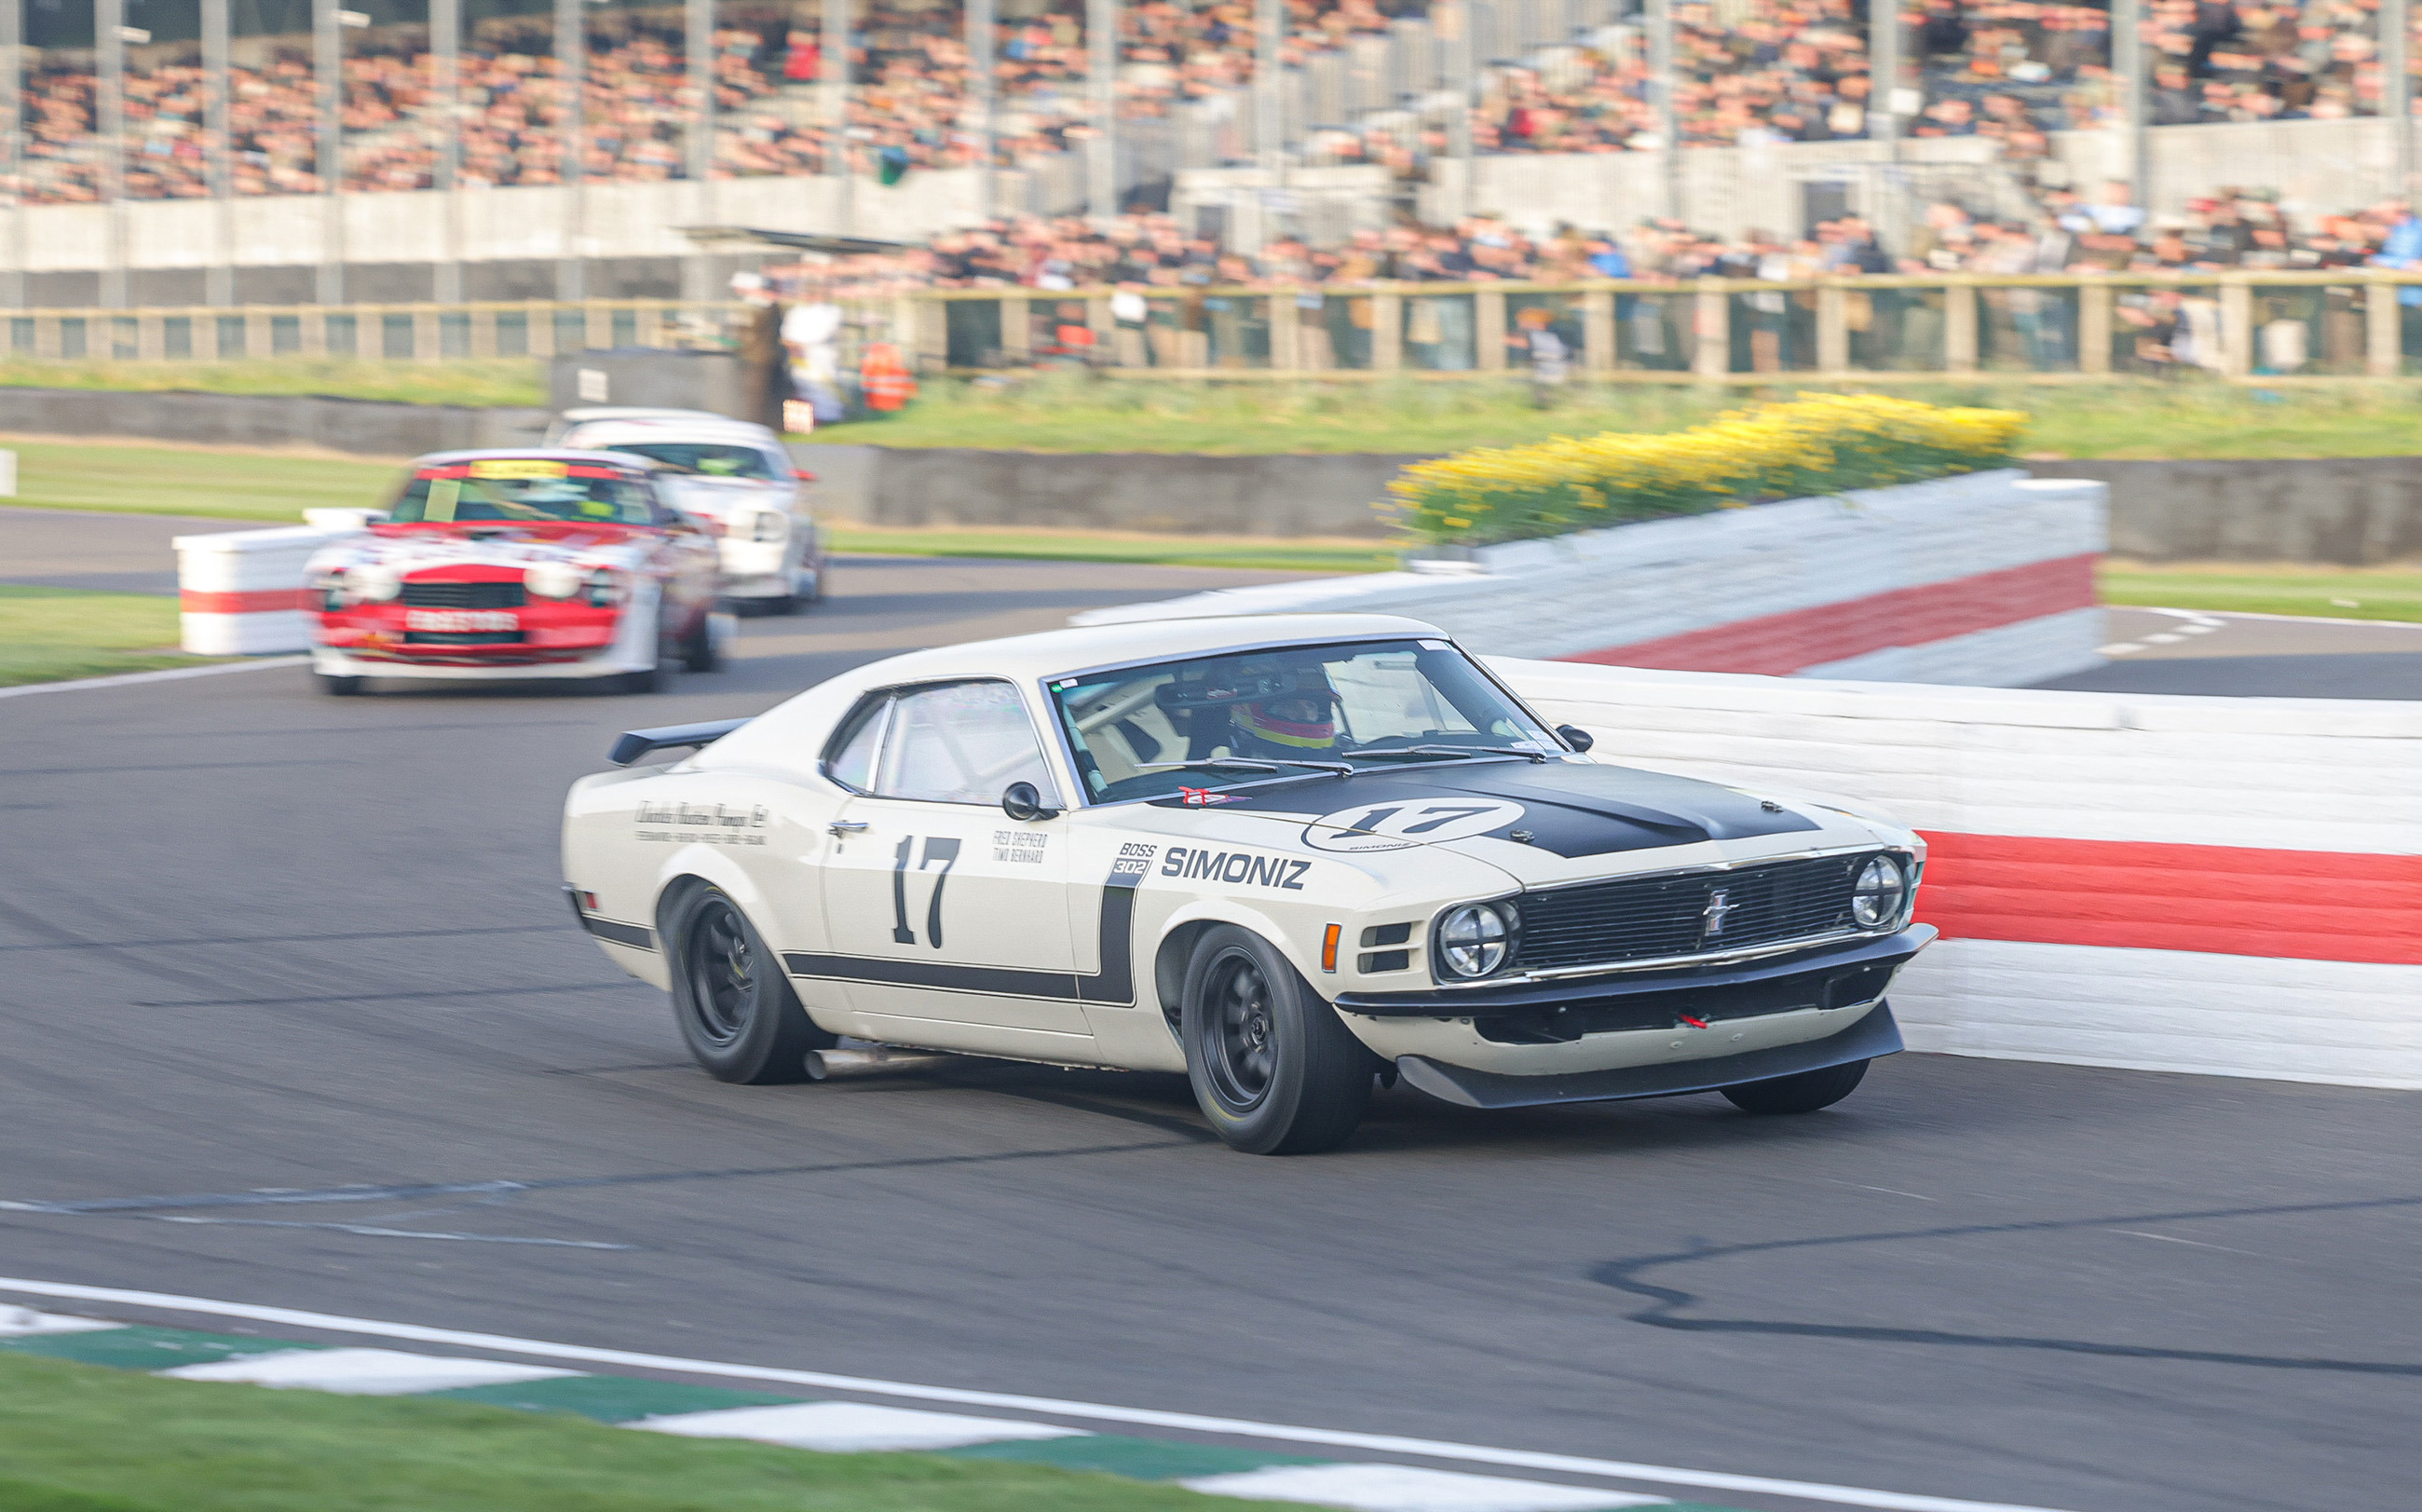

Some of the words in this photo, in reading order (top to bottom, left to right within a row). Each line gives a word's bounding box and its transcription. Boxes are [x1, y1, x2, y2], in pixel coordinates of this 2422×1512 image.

[1328, 807, 1502, 839] 17
[992, 830, 1012, 845] FRED
[1012, 831, 1048, 848] SHEPHERD
[1011, 848, 1044, 864] BERNHARD
[1120, 842, 1157, 857] BOSS
[1113, 860, 1146, 875] 302
[1162, 847, 1312, 891] SIMONIZ
[891, 835, 962, 949] 17
